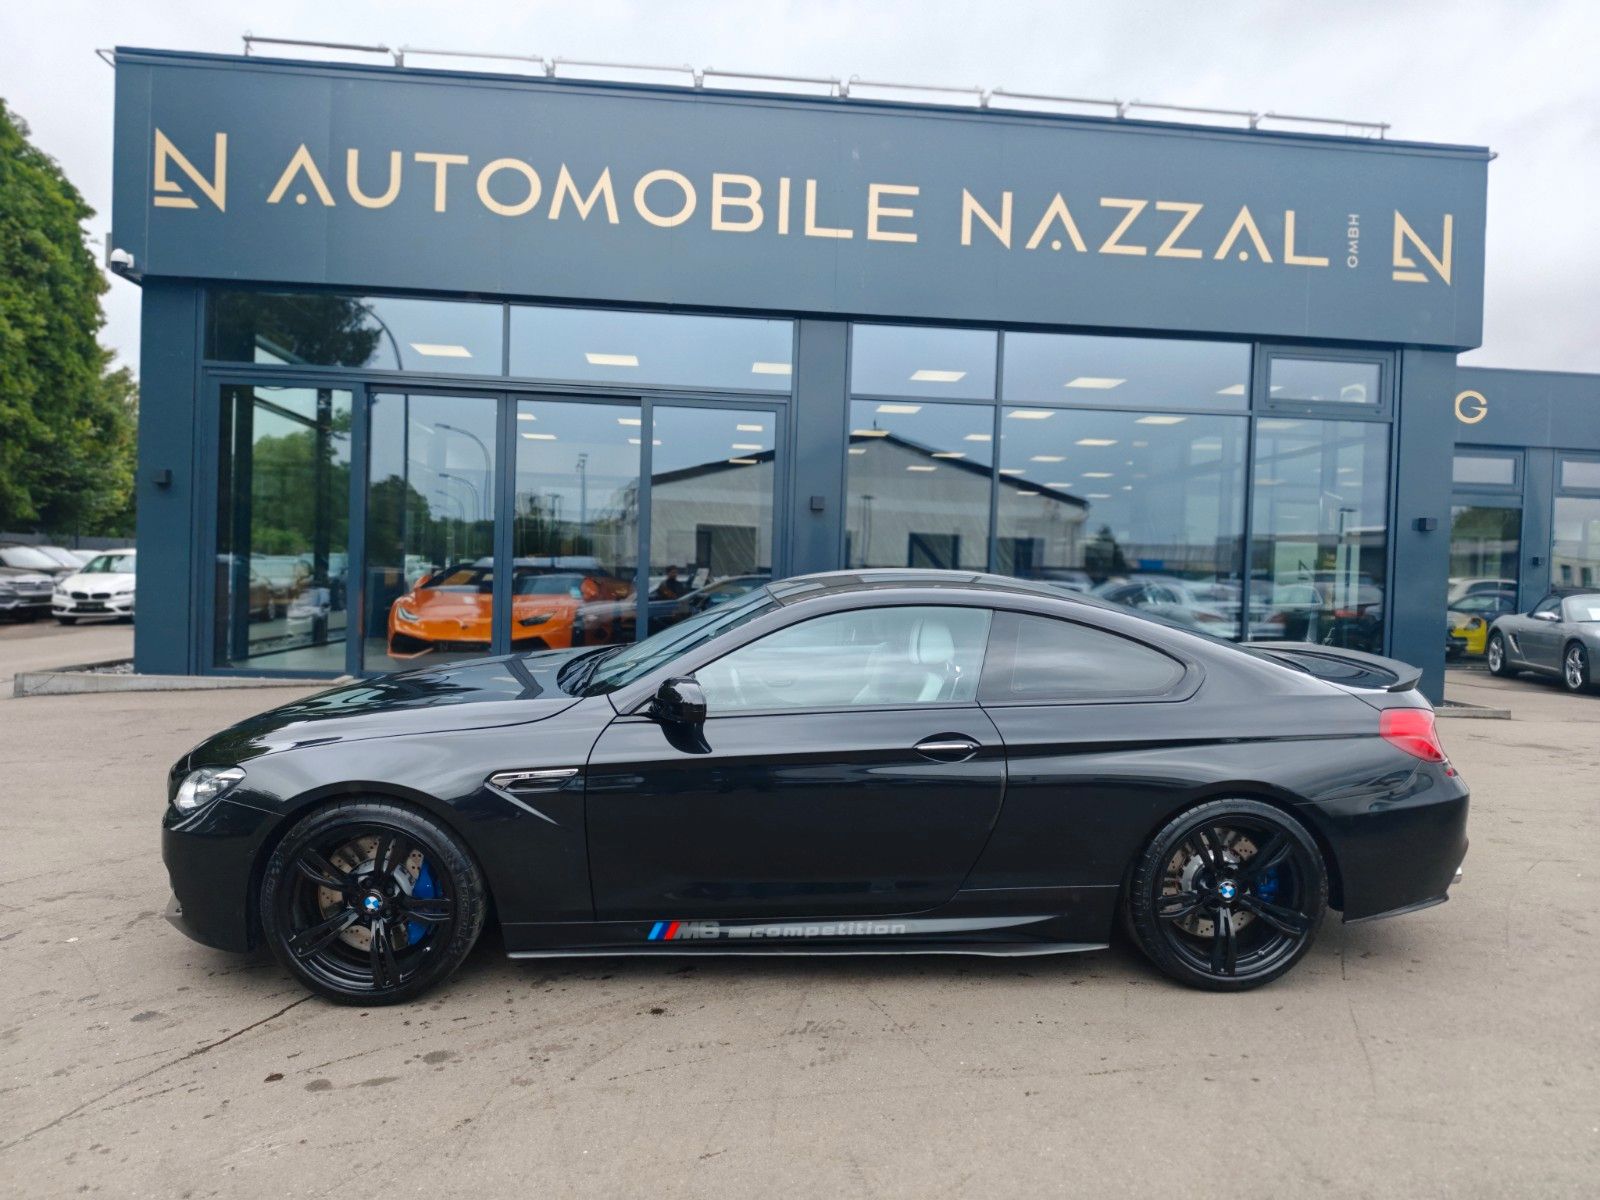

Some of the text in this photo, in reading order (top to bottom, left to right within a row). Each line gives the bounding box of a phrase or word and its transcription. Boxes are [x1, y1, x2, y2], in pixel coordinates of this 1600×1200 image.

[267, 144, 920, 244] AUTOMOBILE
[960, 188, 1330, 268] NAZZAL
[1346, 213, 1360, 269] GMBH
[1454, 390, 1488, 424] G
[673, 920, 906, 939] M6 competition
